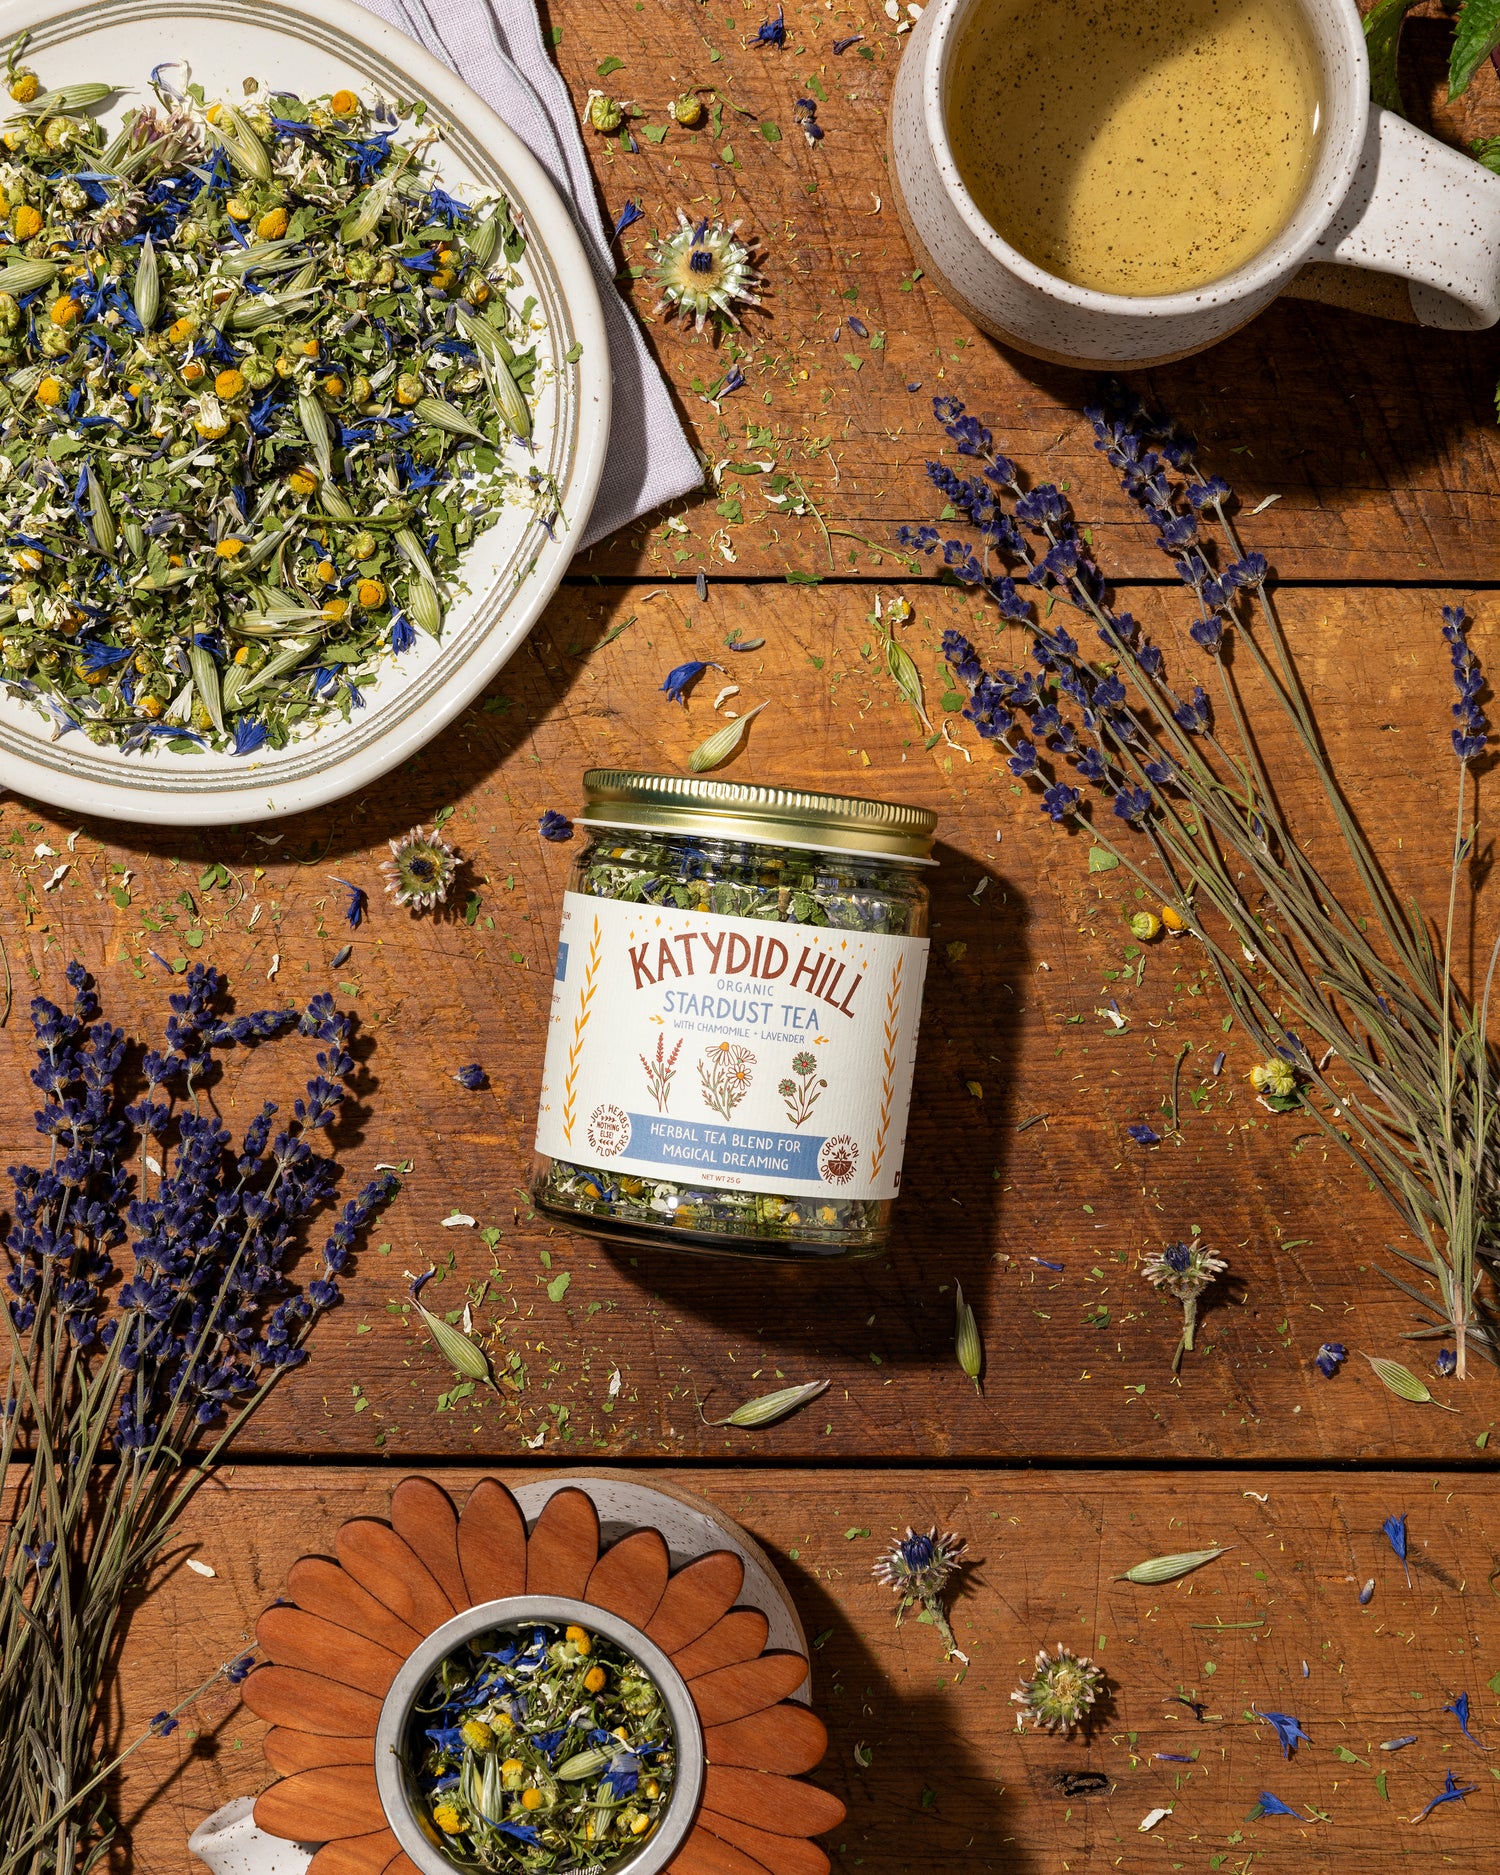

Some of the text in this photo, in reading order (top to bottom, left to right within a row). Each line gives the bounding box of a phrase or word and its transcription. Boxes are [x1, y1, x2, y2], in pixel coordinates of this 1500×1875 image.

[628, 932, 862, 1019] KATYDID HILL
[717, 979, 774, 996] ORGANIC
[663, 990, 819, 1030] STARDUST TEA
[673, 1019, 694, 1030] WITH
[697, 1022, 750, 1038] CHAMOMILE
[761, 1030, 805, 1044] LAVENDER
[590, 1104, 629, 1129] JUST HERBS
[597, 1122, 620, 1132] NOTHING
[587, 1128, 629, 1157] AND FLOWERS
[650, 1123, 801, 1153] HERBAL TEA BLEND FOR
[822, 1134, 859, 1158] GROWN ON
[662, 1144, 789, 1171] MAGICAL DREAMING
[701, 1173, 713, 1181] NET
[820, 1164, 857, 1186] ONE FARM
